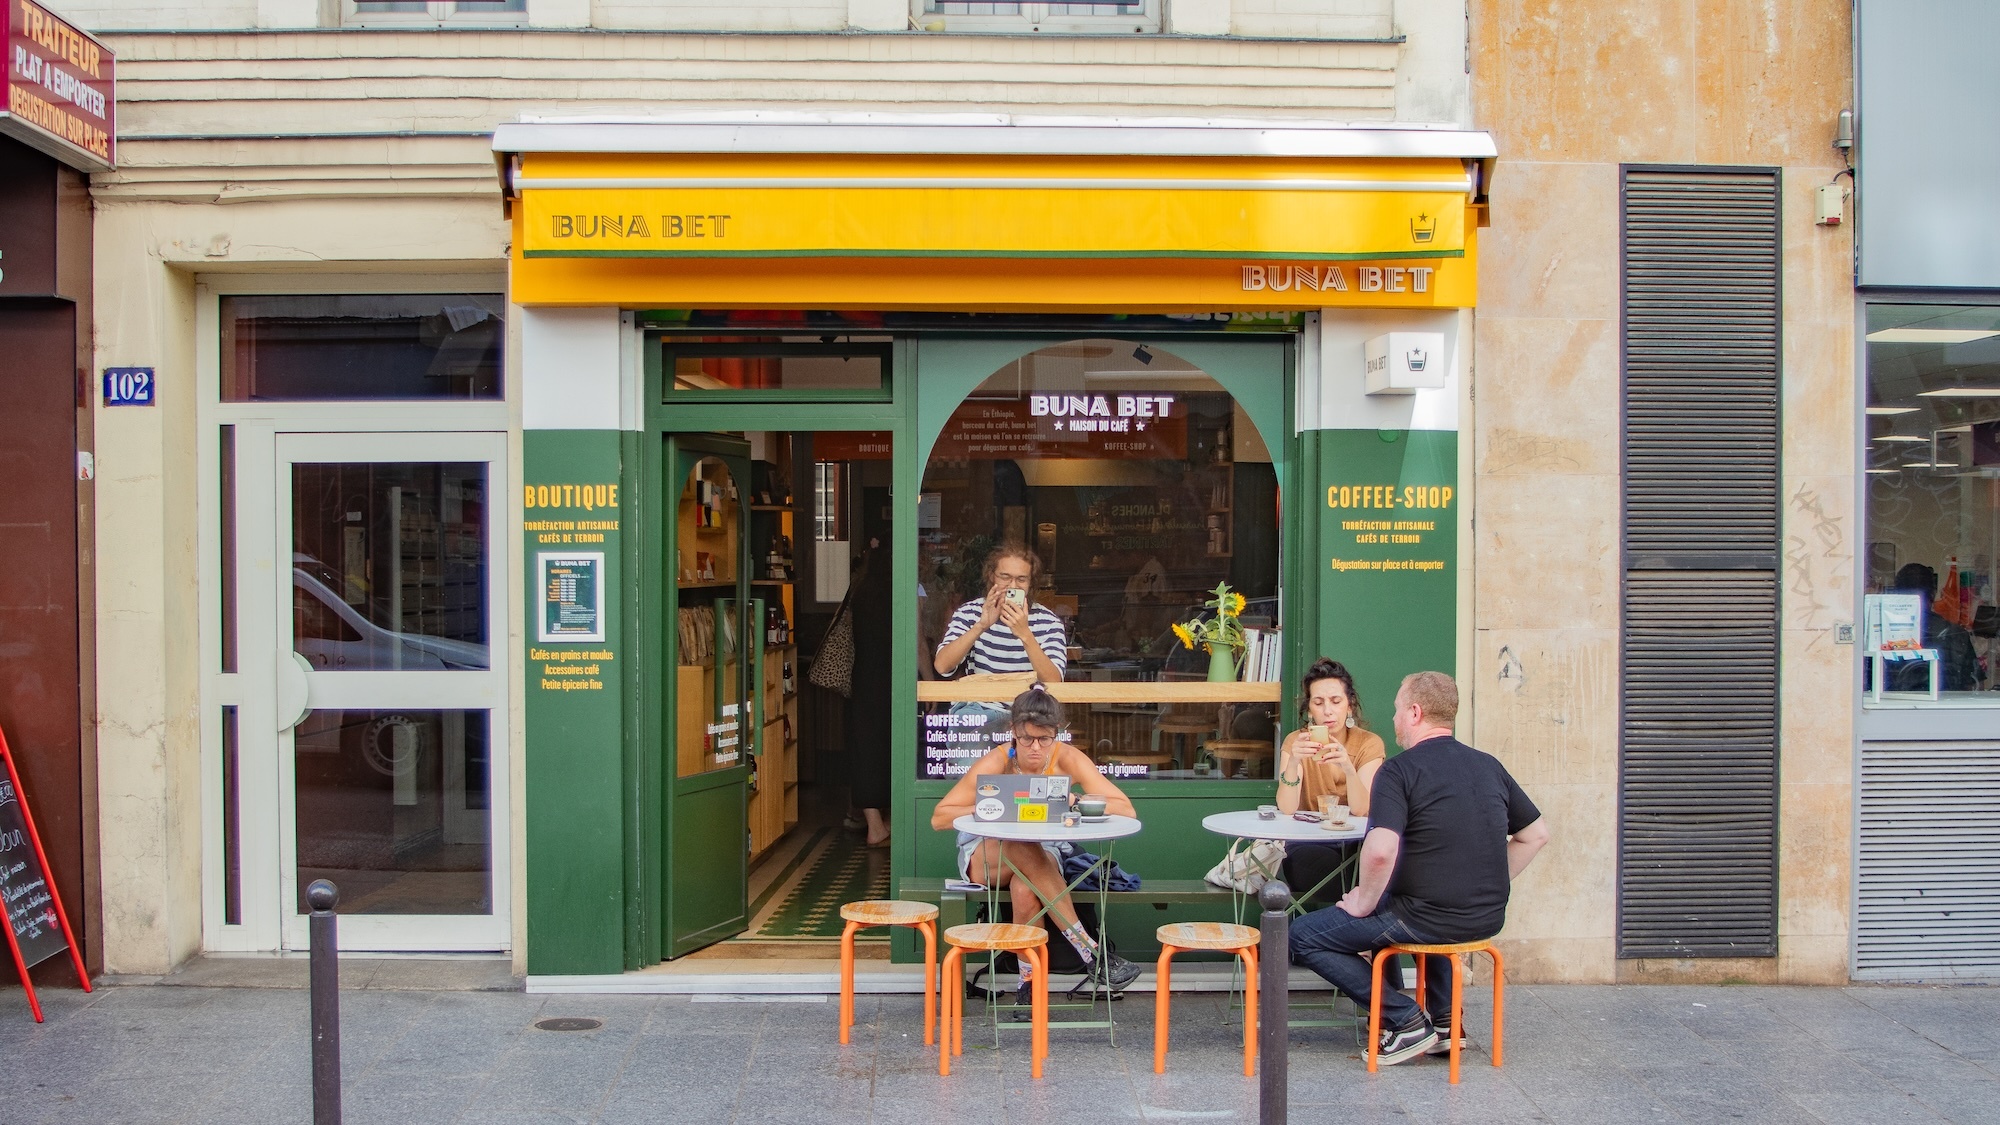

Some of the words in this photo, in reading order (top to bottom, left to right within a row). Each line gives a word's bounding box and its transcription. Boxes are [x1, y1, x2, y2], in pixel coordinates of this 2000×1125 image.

[21, 1, 100, 79] TRAITEUR
[16, 45, 42, 84] PLAT
[44, 62, 52, 91] A
[54, 66, 105, 120] EMPORTER
[10, 83, 67, 138] DEGUSTATION
[67, 114, 84, 146] SUR
[85, 125, 108, 158] PLACE
[552, 215, 651, 238] BUNA
[662, 215, 731, 238] BET
[1241, 265, 1348, 292] BUNA
[1359, 266, 1433, 293] BET
[1378, 355, 1386, 371] BET
[109, 372, 149, 400] 102
[1030, 395, 1111, 417] BUNA
[1117, 396, 1174, 418] BET
[983, 410, 990, 418] En
[962, 421, 985, 429] berceau
[986, 421, 994, 429] du
[1069, 420, 1097, 432] MAISON
[1098, 420, 1109, 432] DU
[1111, 418, 1129, 432] CAFÉ
[964, 432, 970, 440] la
[971, 432, 991, 440] maison
[859, 444, 889, 453] BOUTIQUE
[968, 444, 981, 453] pour
[982, 443, 1008, 453] déguster
[525, 484, 618, 511] BOUTIQUE
[1327, 486, 1452, 508] COFFEE-SHOP
[524, 520, 575, 531] TORRÉFACTION
[577, 521, 619, 530] ARTISANALE
[1341, 520, 1391, 531] TORRÉFACTION
[1393, 521, 1435, 531] ARTISANALE
[538, 532, 561, 543] CAFÉS
[562, 534, 572, 543] DE
[574, 533, 604, 543] TERROIR
[1356, 533, 1377, 543] CAFÉS
[1379, 534, 1389, 543] DE
[1391, 534, 1420, 543] TERROIR
[1331, 558, 1370, 572] Dégustation
[1371, 560, 1382, 570] sur
[1382, 558, 1400, 572] place
[1401, 560, 1408, 570] et
[1409, 559, 1414, 570] à
[1414, 560, 1444, 572] emporter
[531, 648, 550, 660] Cafés
[551, 651, 560, 660] en
[560, 649, 581, 662] grains
[582, 650, 589, 660] et
[590, 648, 614, 660] moulus
[545, 664, 584, 675] Accessoires
[584, 663, 600, 675] café
[542, 678, 561, 690] Petite
[562, 679, 589, 692] épicerie
[589, 678, 603, 690] fine
[926, 714, 988, 727] COFFEE-SHOP
[926, 730, 947, 742] Cafés
[948, 730, 958, 742] de
[958, 731, 981, 742] terroir
[926, 746, 970, 761] Dégustation
[970, 748, 983, 759] sur
[926, 763, 945, 775] Café,
[1108, 763, 1114, 774] à
[1114, 763, 1148, 777] grignoter
